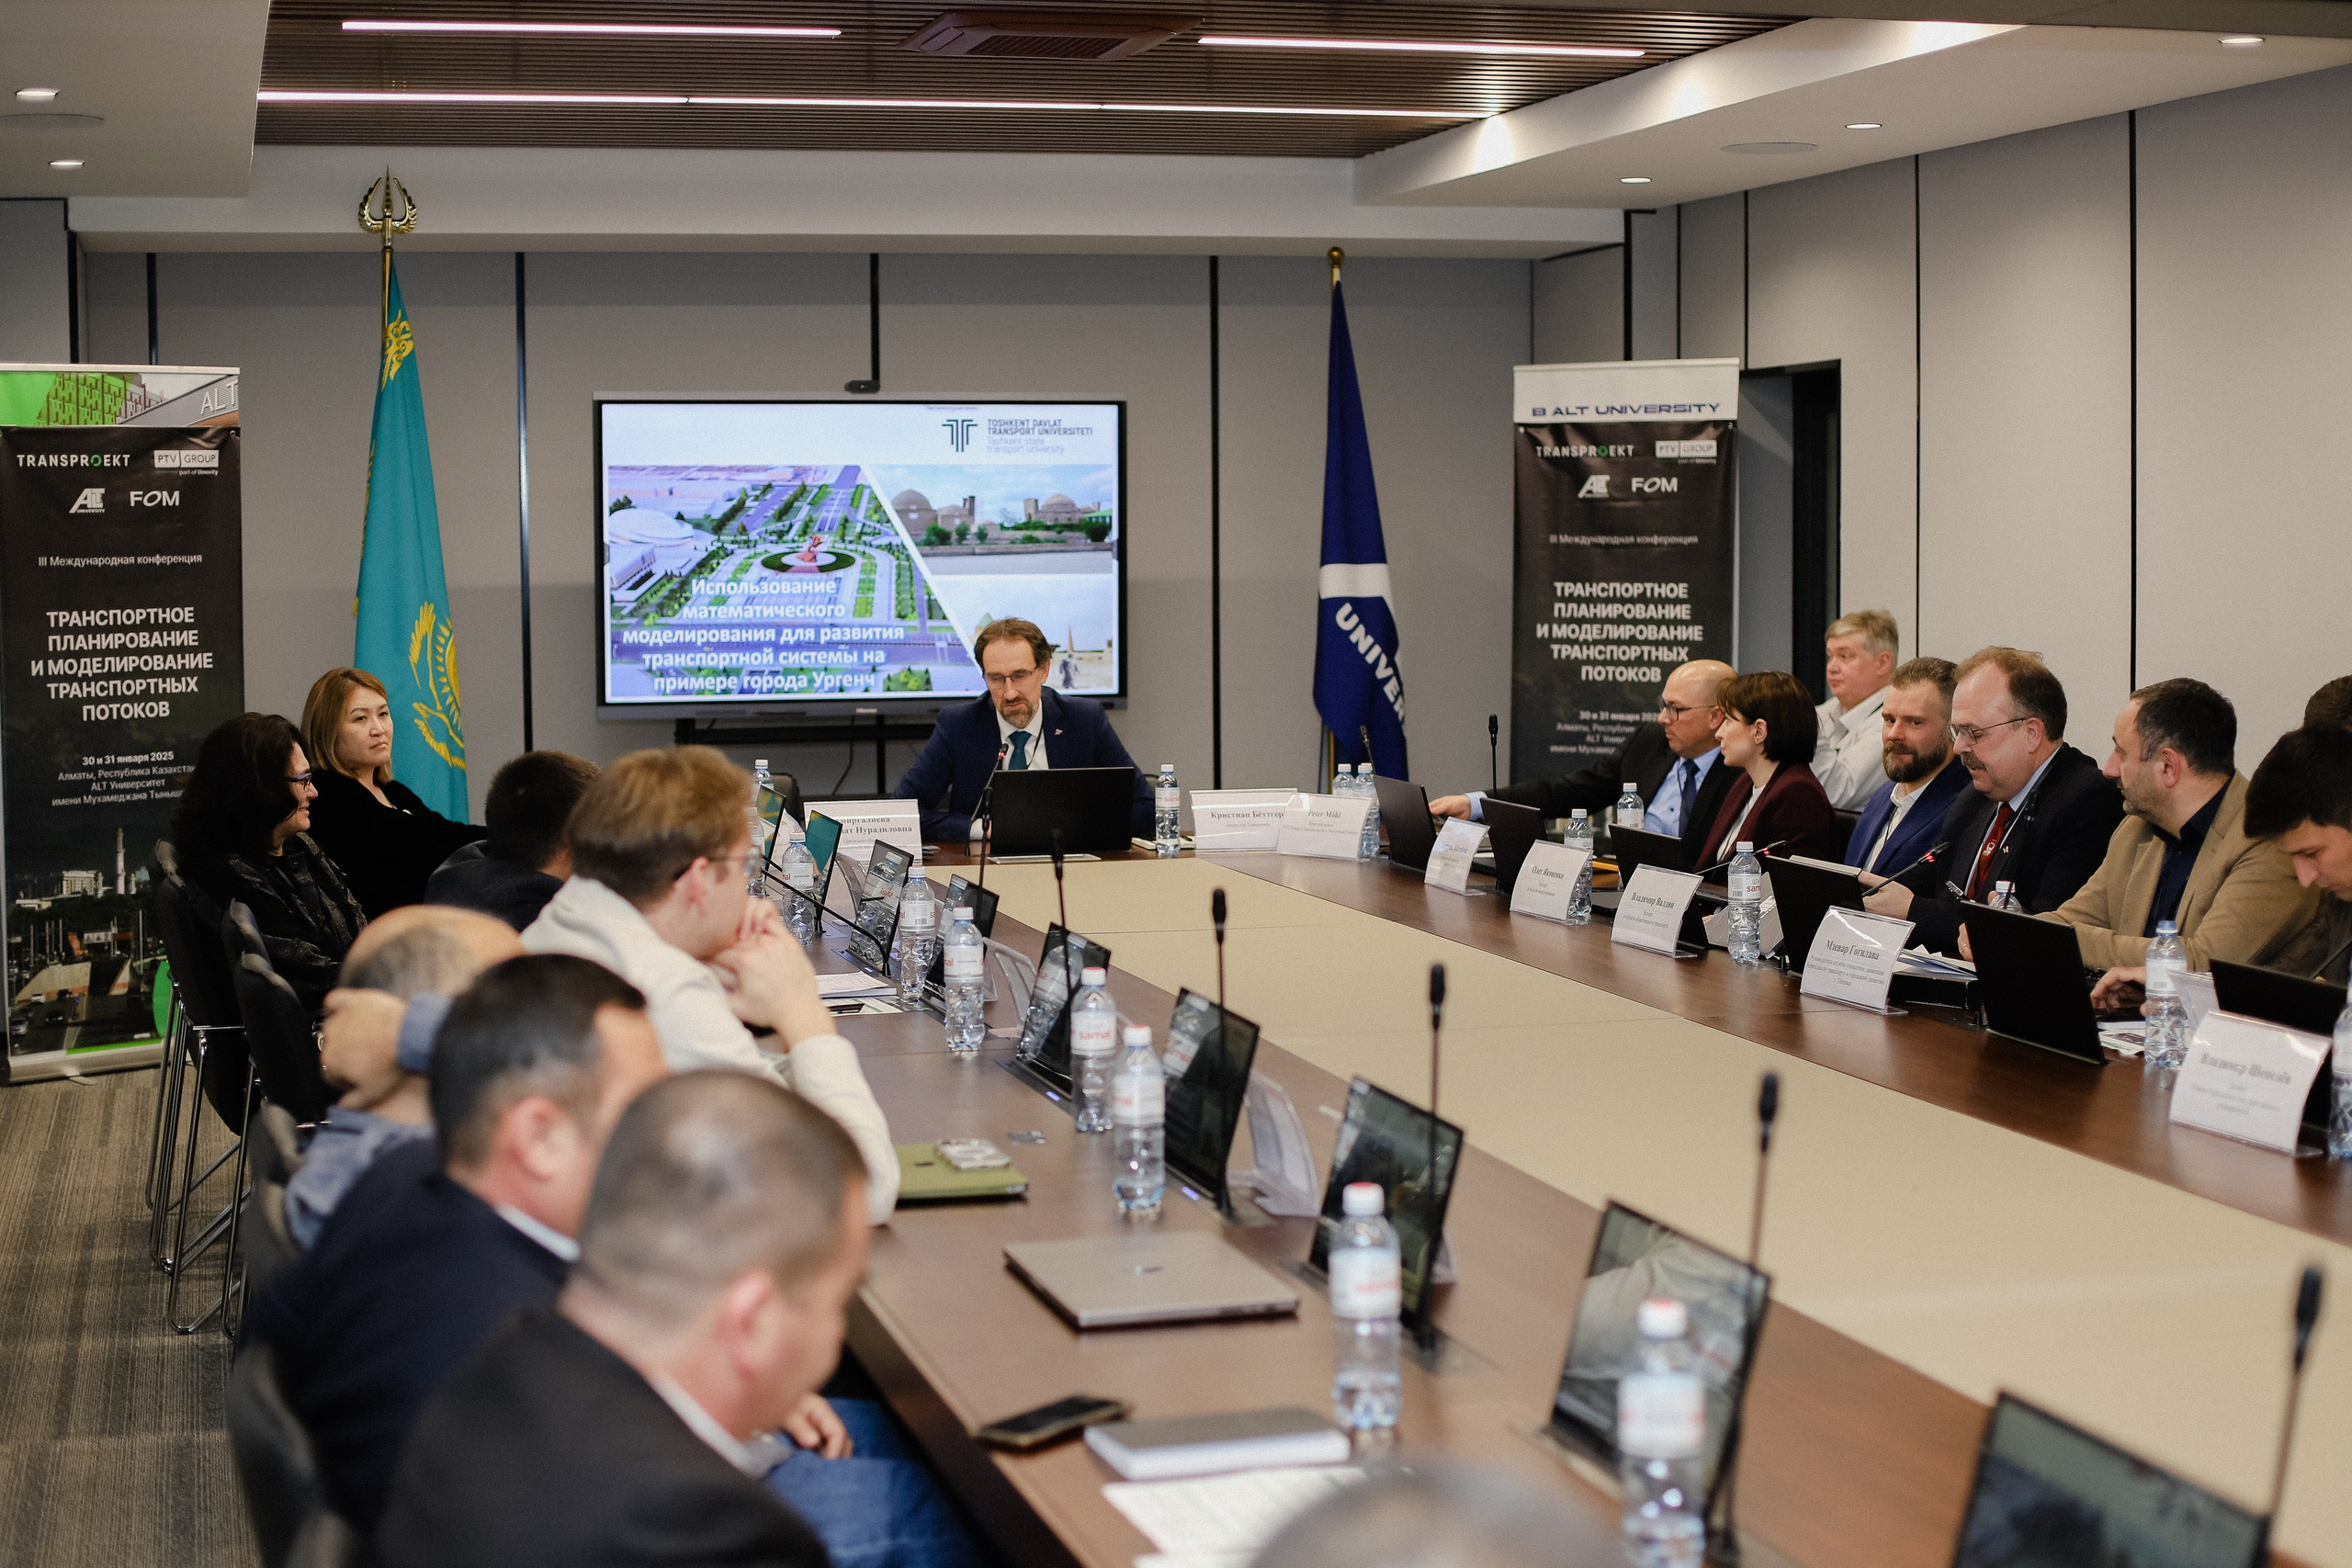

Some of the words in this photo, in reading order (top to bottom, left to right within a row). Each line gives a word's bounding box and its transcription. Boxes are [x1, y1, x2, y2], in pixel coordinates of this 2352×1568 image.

[200, 378, 239, 414] ALT
[1553, 406, 1589, 415] ALT
[1595, 402, 1720, 415] UNIVERSITY
[988, 419, 1030, 427] TOSHKENT
[988, 426, 1035, 435] TRANSPORT
[1037, 427, 1093, 435] UNIVERSITETI
[1535, 445, 1634, 457] TRANSPROEKT
[1659, 445, 1677, 453] PTV
[1683, 444, 1713, 453] GROUP
[17, 454, 130, 468] TRANSPROEKT
[157, 454, 176, 463] PTV
[184, 454, 216, 463] GROUP
[1631, 477, 1679, 492] FOM
[130, 491, 180, 507] FOM
[1559, 535, 1634, 545] Международная
[1635, 534, 1699, 545] конференция
[50, 555, 135, 568] Международная
[137, 554, 203, 566] конференция
[691, 578, 837, 595] Использование
[1554, 581, 1689, 599] ТРАНСПОРТНОЕ
[46, 606, 195, 627] ТРАНСПОРТНОЕ
[683, 603, 846, 619] математического
[1553, 603, 1692, 620] ПЛАНИРОВАНИЕ
[48, 630, 198, 651] ПЛАНИРОВАНИЕ
[622, 626, 775, 645] моделирования
[779, 627, 815, 645] для
[819, 626, 905, 643] развития
[1536, 623, 1549, 638] И
[1552, 623, 1703, 642] МОДЕЛИРОВАНИЕ
[642, 648, 774, 669] транспортной
[777, 649, 858, 665] системы
[862, 649, 886, 663] на
[1550, 644, 1689, 662] ТРАНСПОРТНЫХ
[30, 660, 44, 676] И
[48, 652, 214, 678] МОДЕЛИРОВАНИЕ
[1580, 665, 1662, 682] ПОТОКОВ
[47, 676, 198, 699] ТРАНСПОРТНЫХ
[652, 676, 737, 694] примере
[742, 674, 808, 691] города
[811, 671, 876, 690] Ургенч
[82, 701, 171, 721] ПОТОКОВ
[1641, 712, 1659, 721] 202
[82, 756, 96, 766] 30
[96, 757, 103, 765] и
[104, 754, 116, 764] 31
[117, 753, 149, 764] января
[150, 750, 175, 761] 2025
[58, 771, 96, 781] Алматы,
[97, 767, 150, 779] Республика
[90, 781, 107, 791] ALT
[109, 779, 165, 791] Университет
[51, 796, 82, 807] имени
[83, 791, 148, 805] Мухамеджана
[1211, 811, 1250, 820] Кристиан
[855, 826, 912, 835] Нурадиловна
[1826, 940, 1849, 955] Мзевар
[1849, 944, 1881, 960] Гогилава
